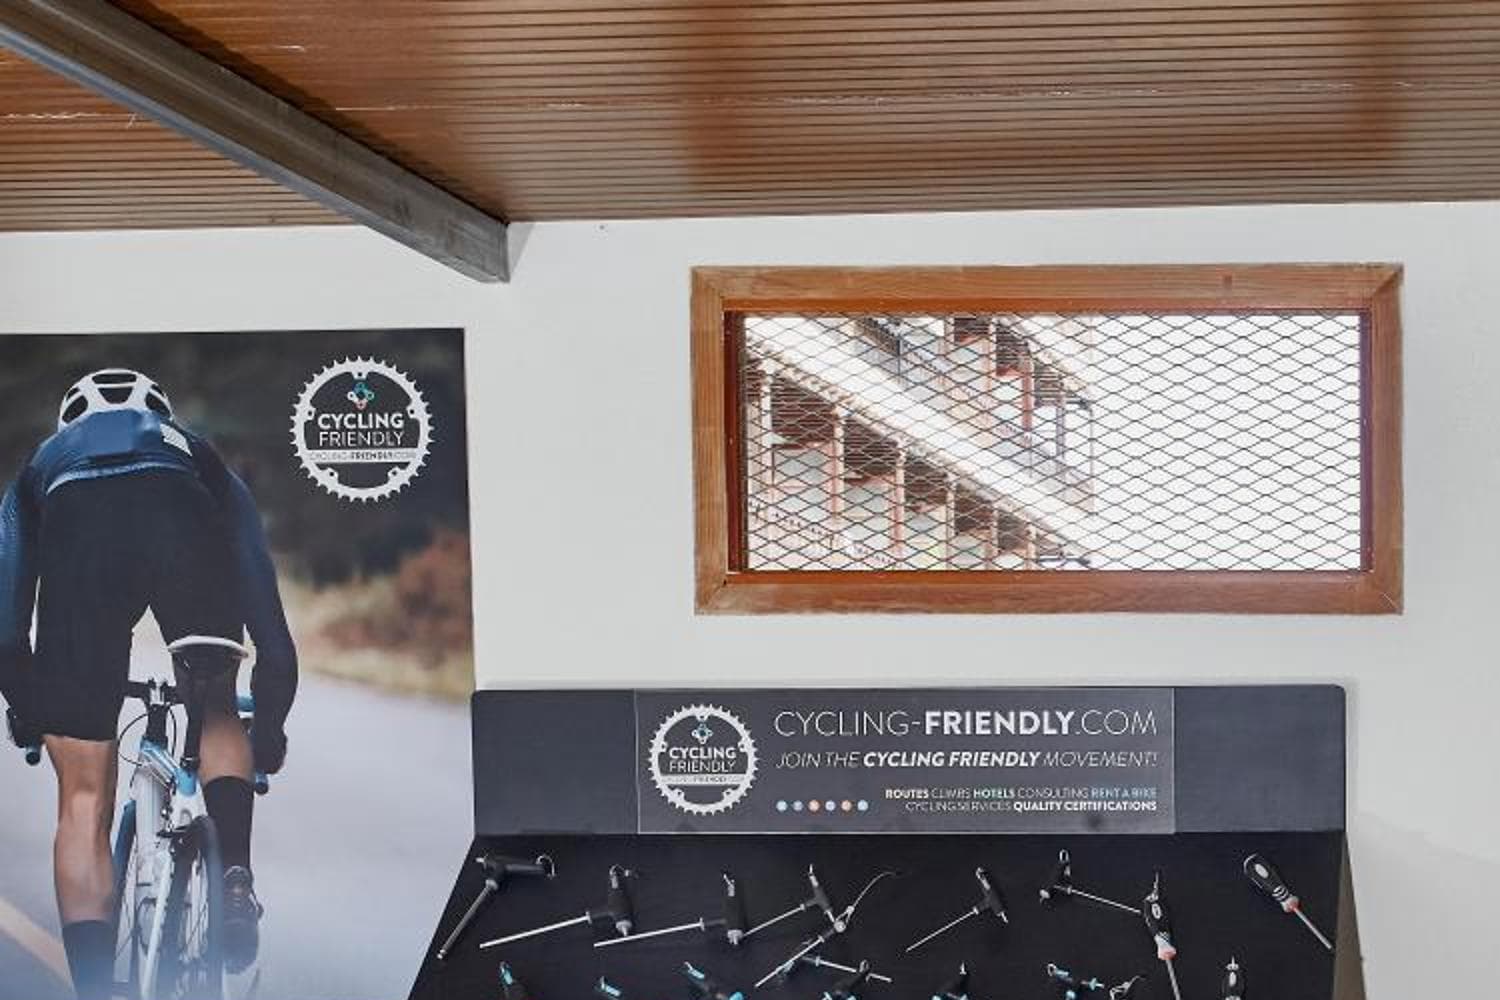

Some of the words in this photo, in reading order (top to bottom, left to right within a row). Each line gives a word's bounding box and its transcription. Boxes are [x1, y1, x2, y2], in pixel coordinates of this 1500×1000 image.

[317, 412, 405, 429] CYCLING
[319, 431, 405, 447] FRIENDLY
[774, 709, 1157, 737] CYCLING-FRIENDLY.COM
[669, 747, 736, 760] CYCLING
[776, 752, 822, 769] JOIN
[826, 752, 860, 768] THE
[863, 751, 945, 768] CYCLING
[949, 751, 1041, 767] FRIENDLY
[1043, 751, 1158, 767] MOVEMENT!
[669, 760, 737, 774] FRIENDLY
[885, 788, 929, 799] ROUTES
[973, 788, 1015, 799] HOTELS
[1013, 801, 1062, 813] QUALITY
[1063, 801, 1157, 811] CERTIFICATIONS
